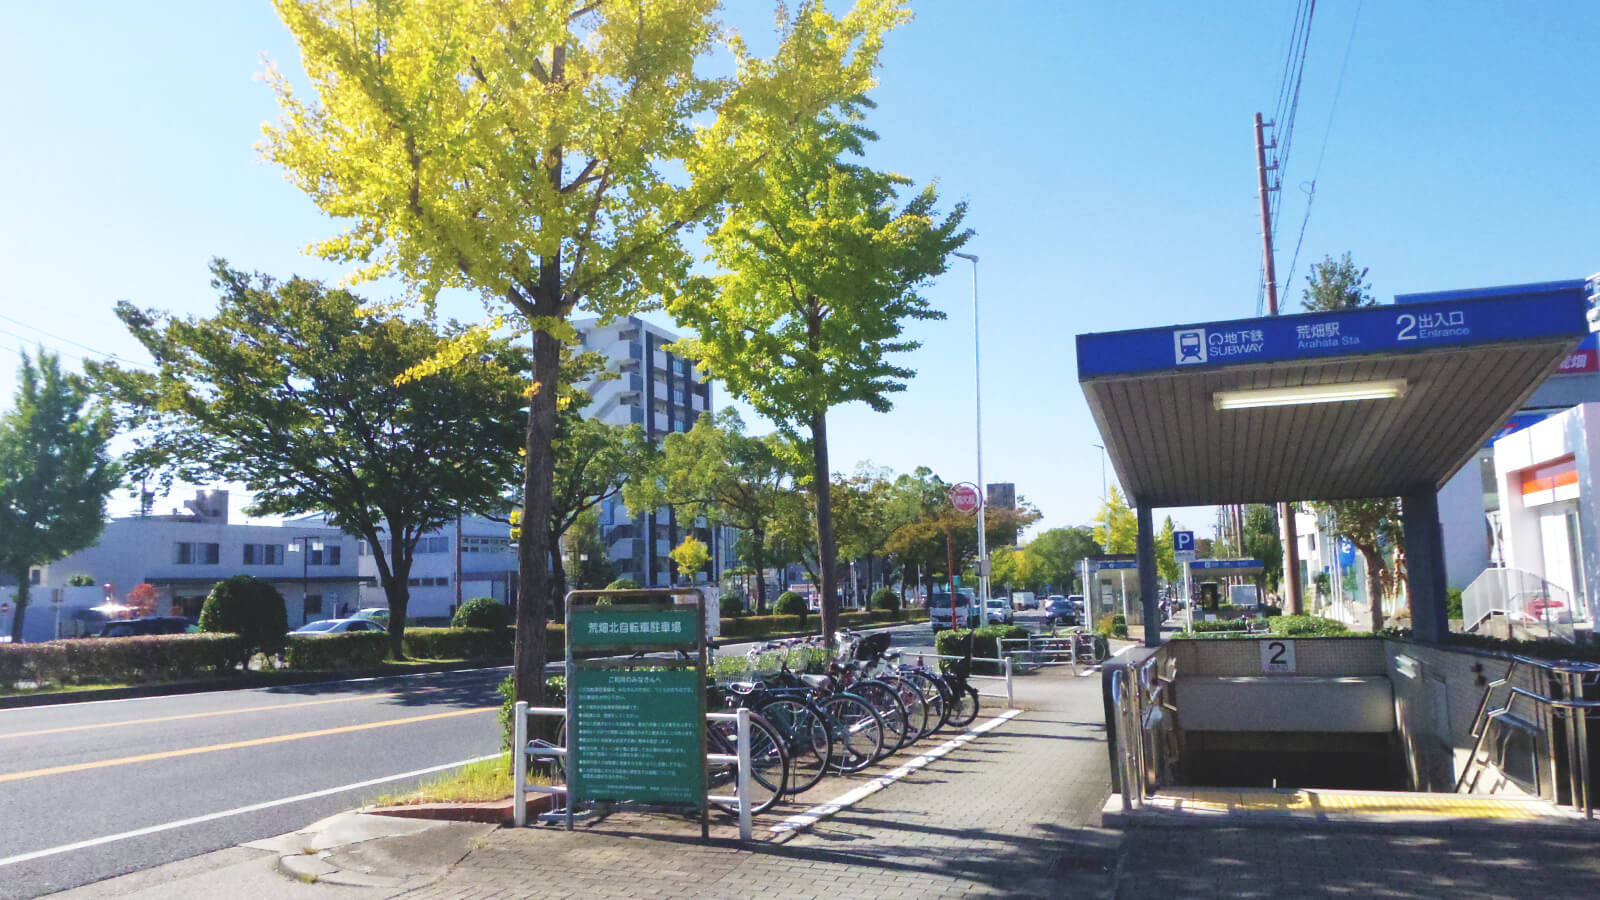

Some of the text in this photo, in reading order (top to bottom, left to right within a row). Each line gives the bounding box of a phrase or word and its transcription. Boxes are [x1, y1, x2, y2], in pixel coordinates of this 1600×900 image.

[1296, 321, 1340, 339] 荒畑駅
[1396, 311, 1464, 340] 2 出入口
[1419, 327, 1471, 338] Entrance
[1223, 329, 1264, 344] 地下鉄
[1298, 335, 1360, 349] Arahata Sta
[1209, 342, 1265, 357] SUBWAY
[1178, 533, 1190, 549] P
[588, 621, 682, 634] 荒畑北自転車駐車場
[1268, 641, 1288, 665] 2
